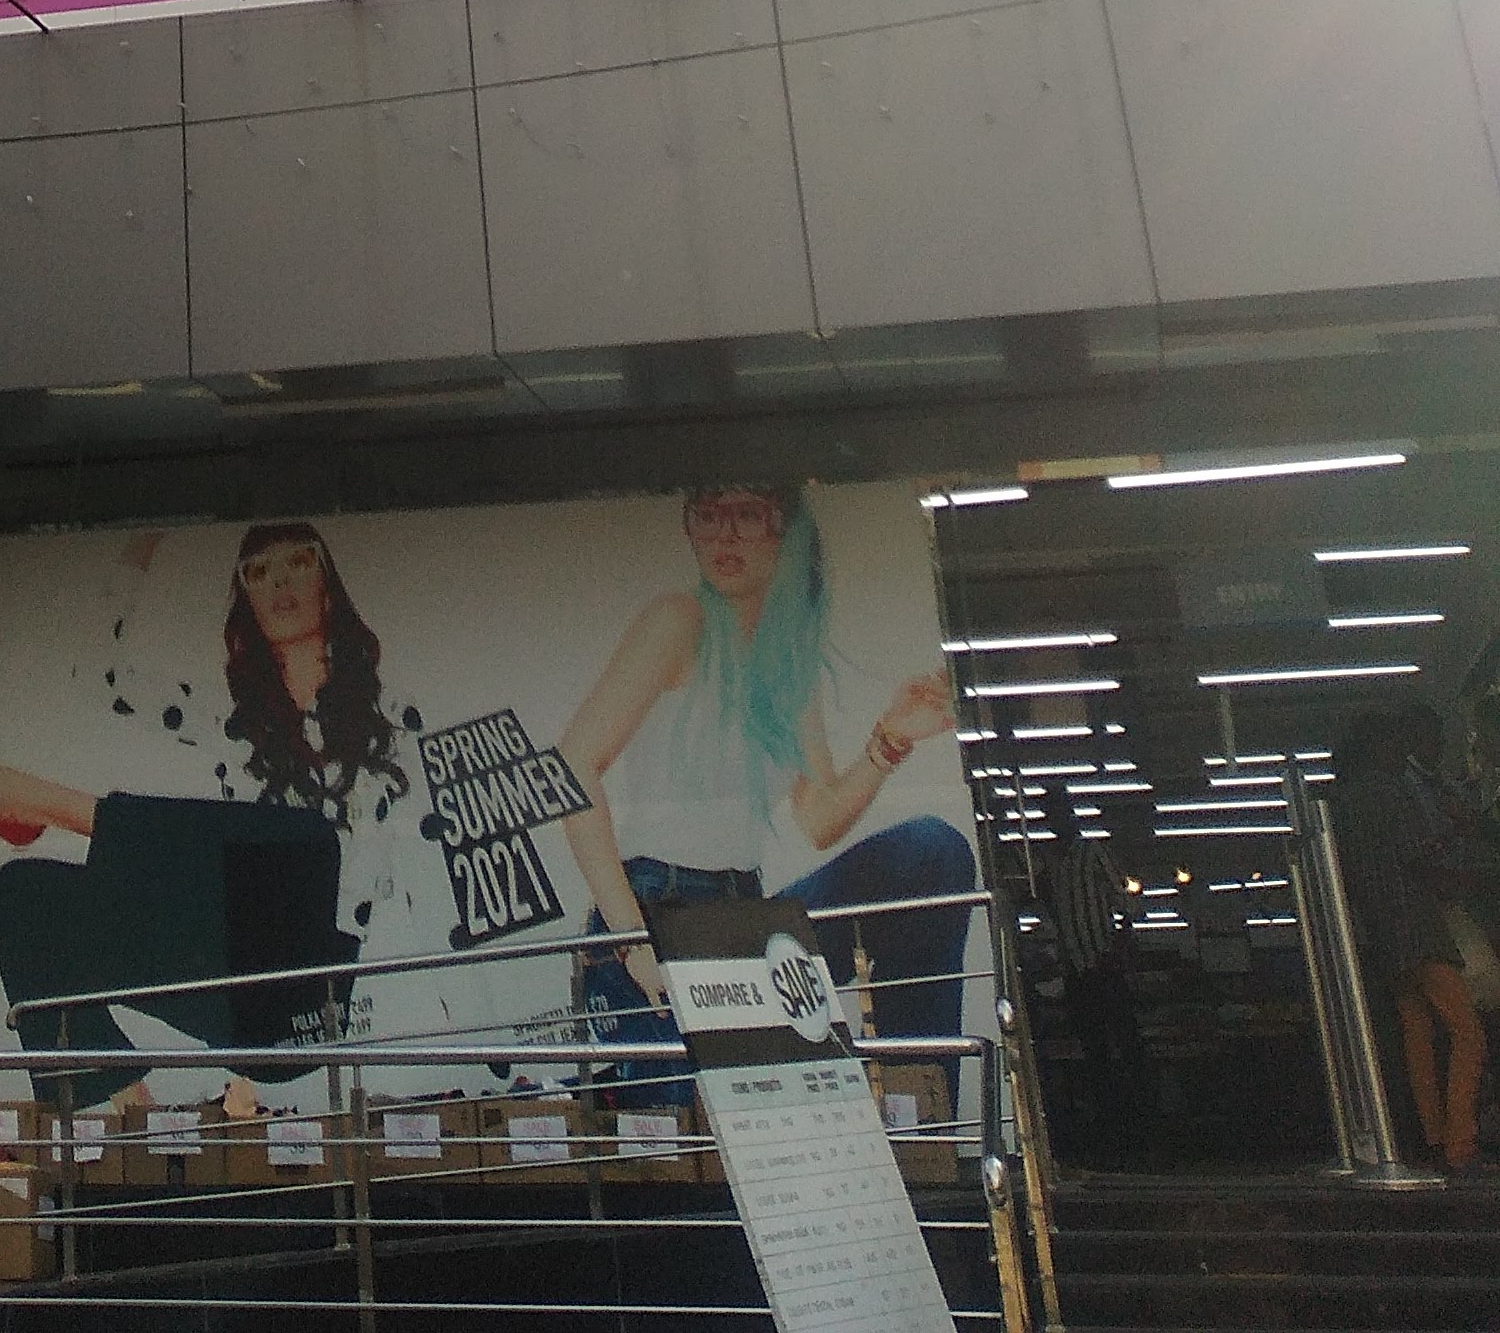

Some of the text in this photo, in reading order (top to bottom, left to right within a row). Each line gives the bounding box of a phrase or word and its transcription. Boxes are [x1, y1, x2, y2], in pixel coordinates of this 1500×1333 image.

[422, 713, 529, 786] SPRING
[436, 754, 586, 848] SUMMER
[451, 833, 552, 937] 2021
[689, 983, 752, 1009] COMPARE
